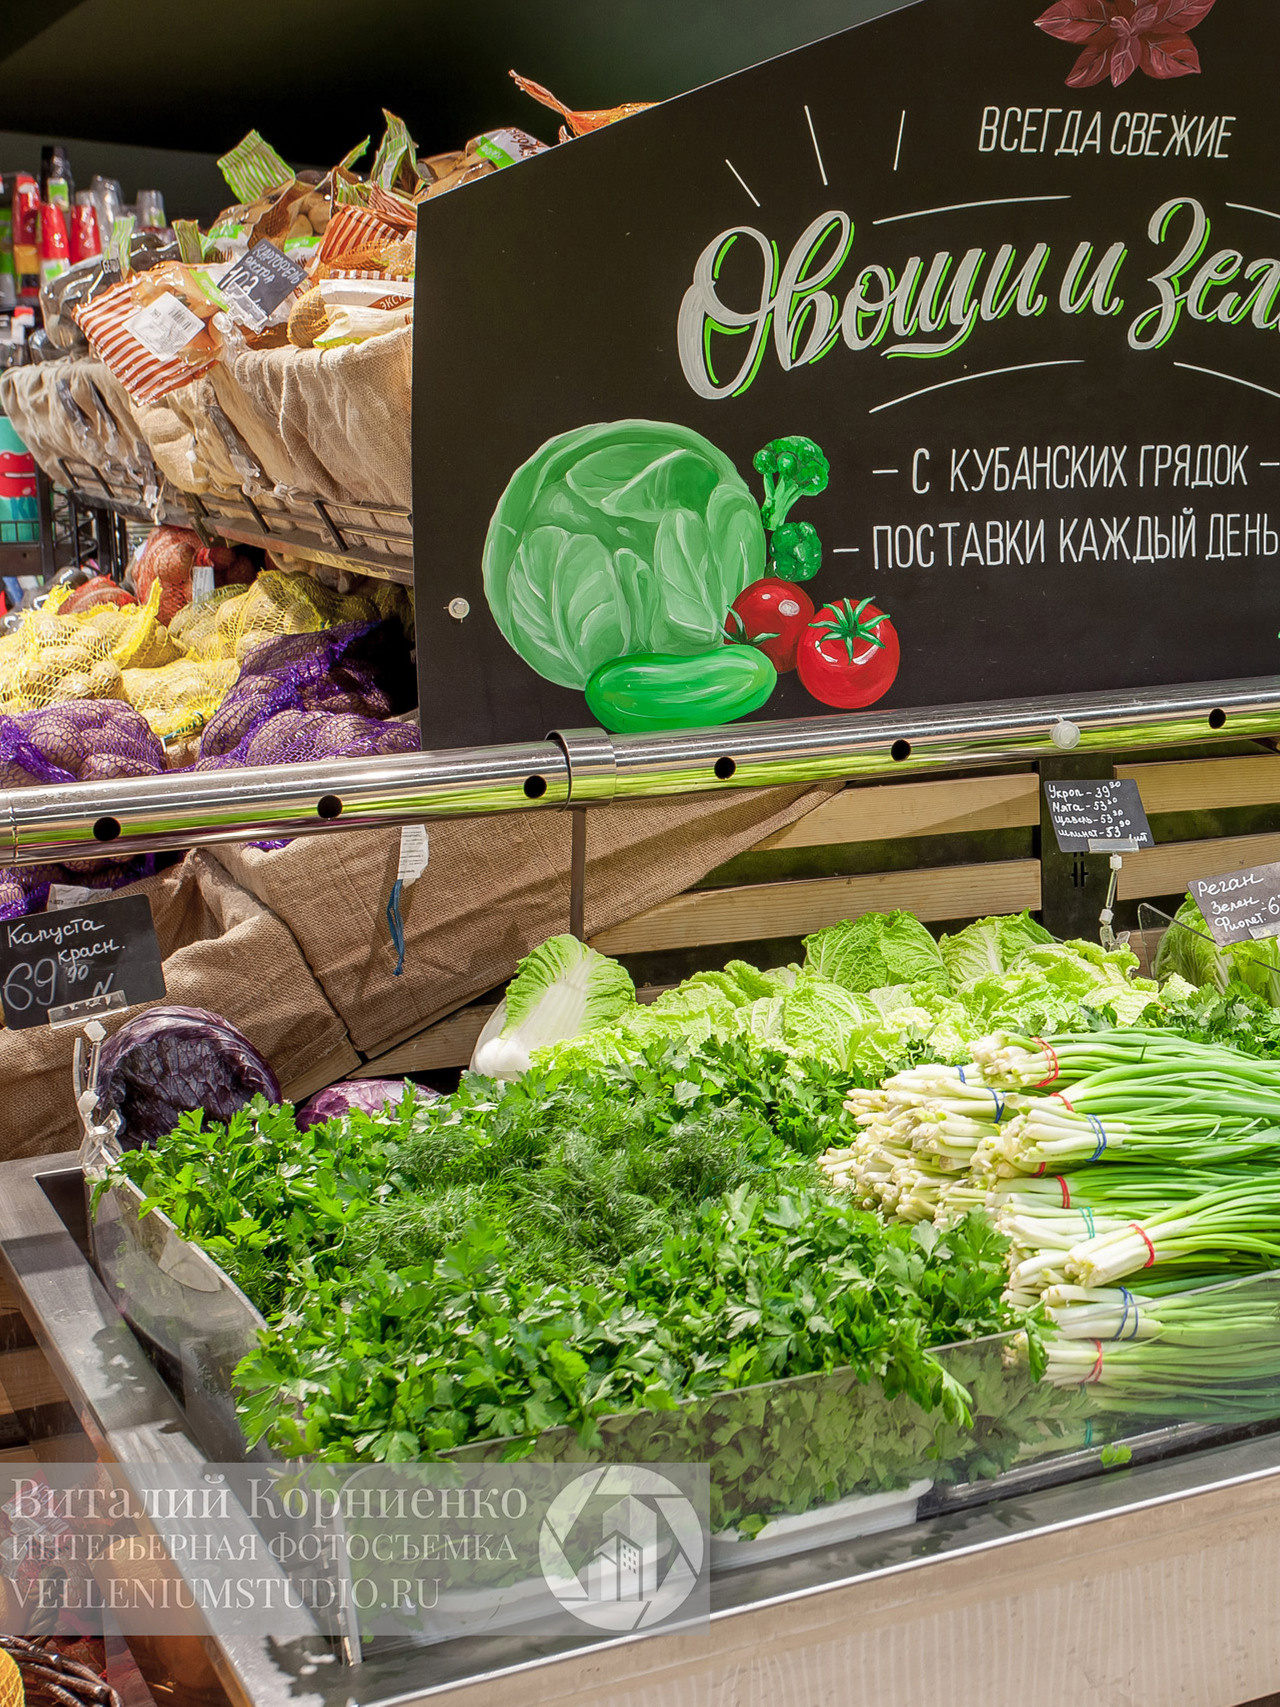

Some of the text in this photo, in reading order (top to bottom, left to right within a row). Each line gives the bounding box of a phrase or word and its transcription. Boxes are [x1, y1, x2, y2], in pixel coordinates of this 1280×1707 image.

[978, 106, 1237, 159] ВСЕГДА СВЕЖИЕ
[677, 210, 1049, 400] Овощи
[1059, 241, 1128, 316] и
[912, 447, 930, 494] С
[950, 445, 1128, 493] КУБАНСКИХ
[1139, 444, 1249, 490] ГРЯДОК
[872, 518, 1045, 570] ПОСТАВКИ
[1059, 506, 1196, 564] КАЖДЫЙ
[1205, 513, 1279, 561] ДЕНЬ
[1048, 784, 1084, 802] Укроп
[1052, 802, 1085, 813] Мята
[1054, 815, 1093, 826] Щавель
[1197, 873, 1264, 897] Реган
[7, 918, 105, 948] Капуста
[57, 938, 126, 965] красн.
[2, 958, 57, 1011] 69
